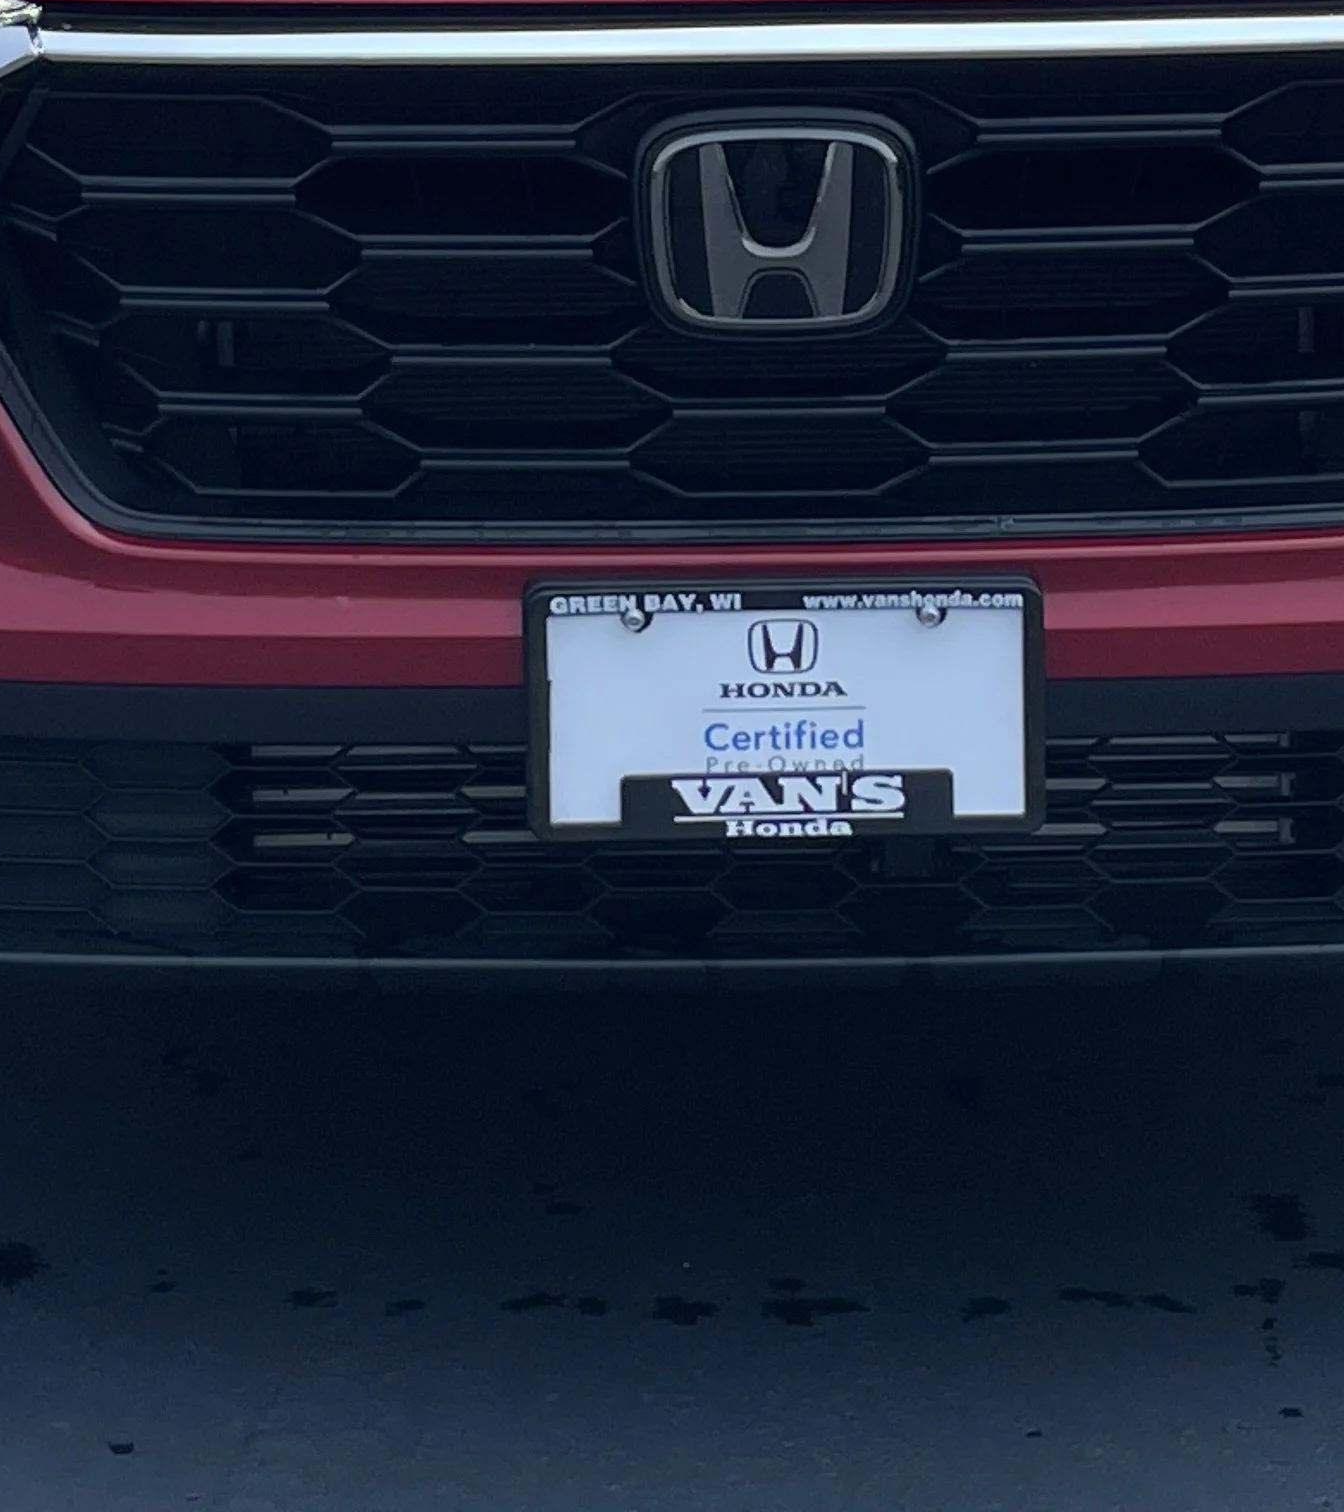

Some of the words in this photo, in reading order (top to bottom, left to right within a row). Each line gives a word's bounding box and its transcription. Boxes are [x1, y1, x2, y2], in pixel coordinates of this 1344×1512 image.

[549, 594, 637, 614] GREEN
[644, 593, 704, 614] BAY,
[709, 593, 742, 610] WI
[803, 590, 1023, 609] www.vanshonda.com
[719, 681, 848, 699] HONDA
[704, 718, 865, 751] Certified
[706, 753, 865, 774] Pre-Owned
[671, 770, 906, 815] VAN'S
[725, 818, 853, 837] Honda
